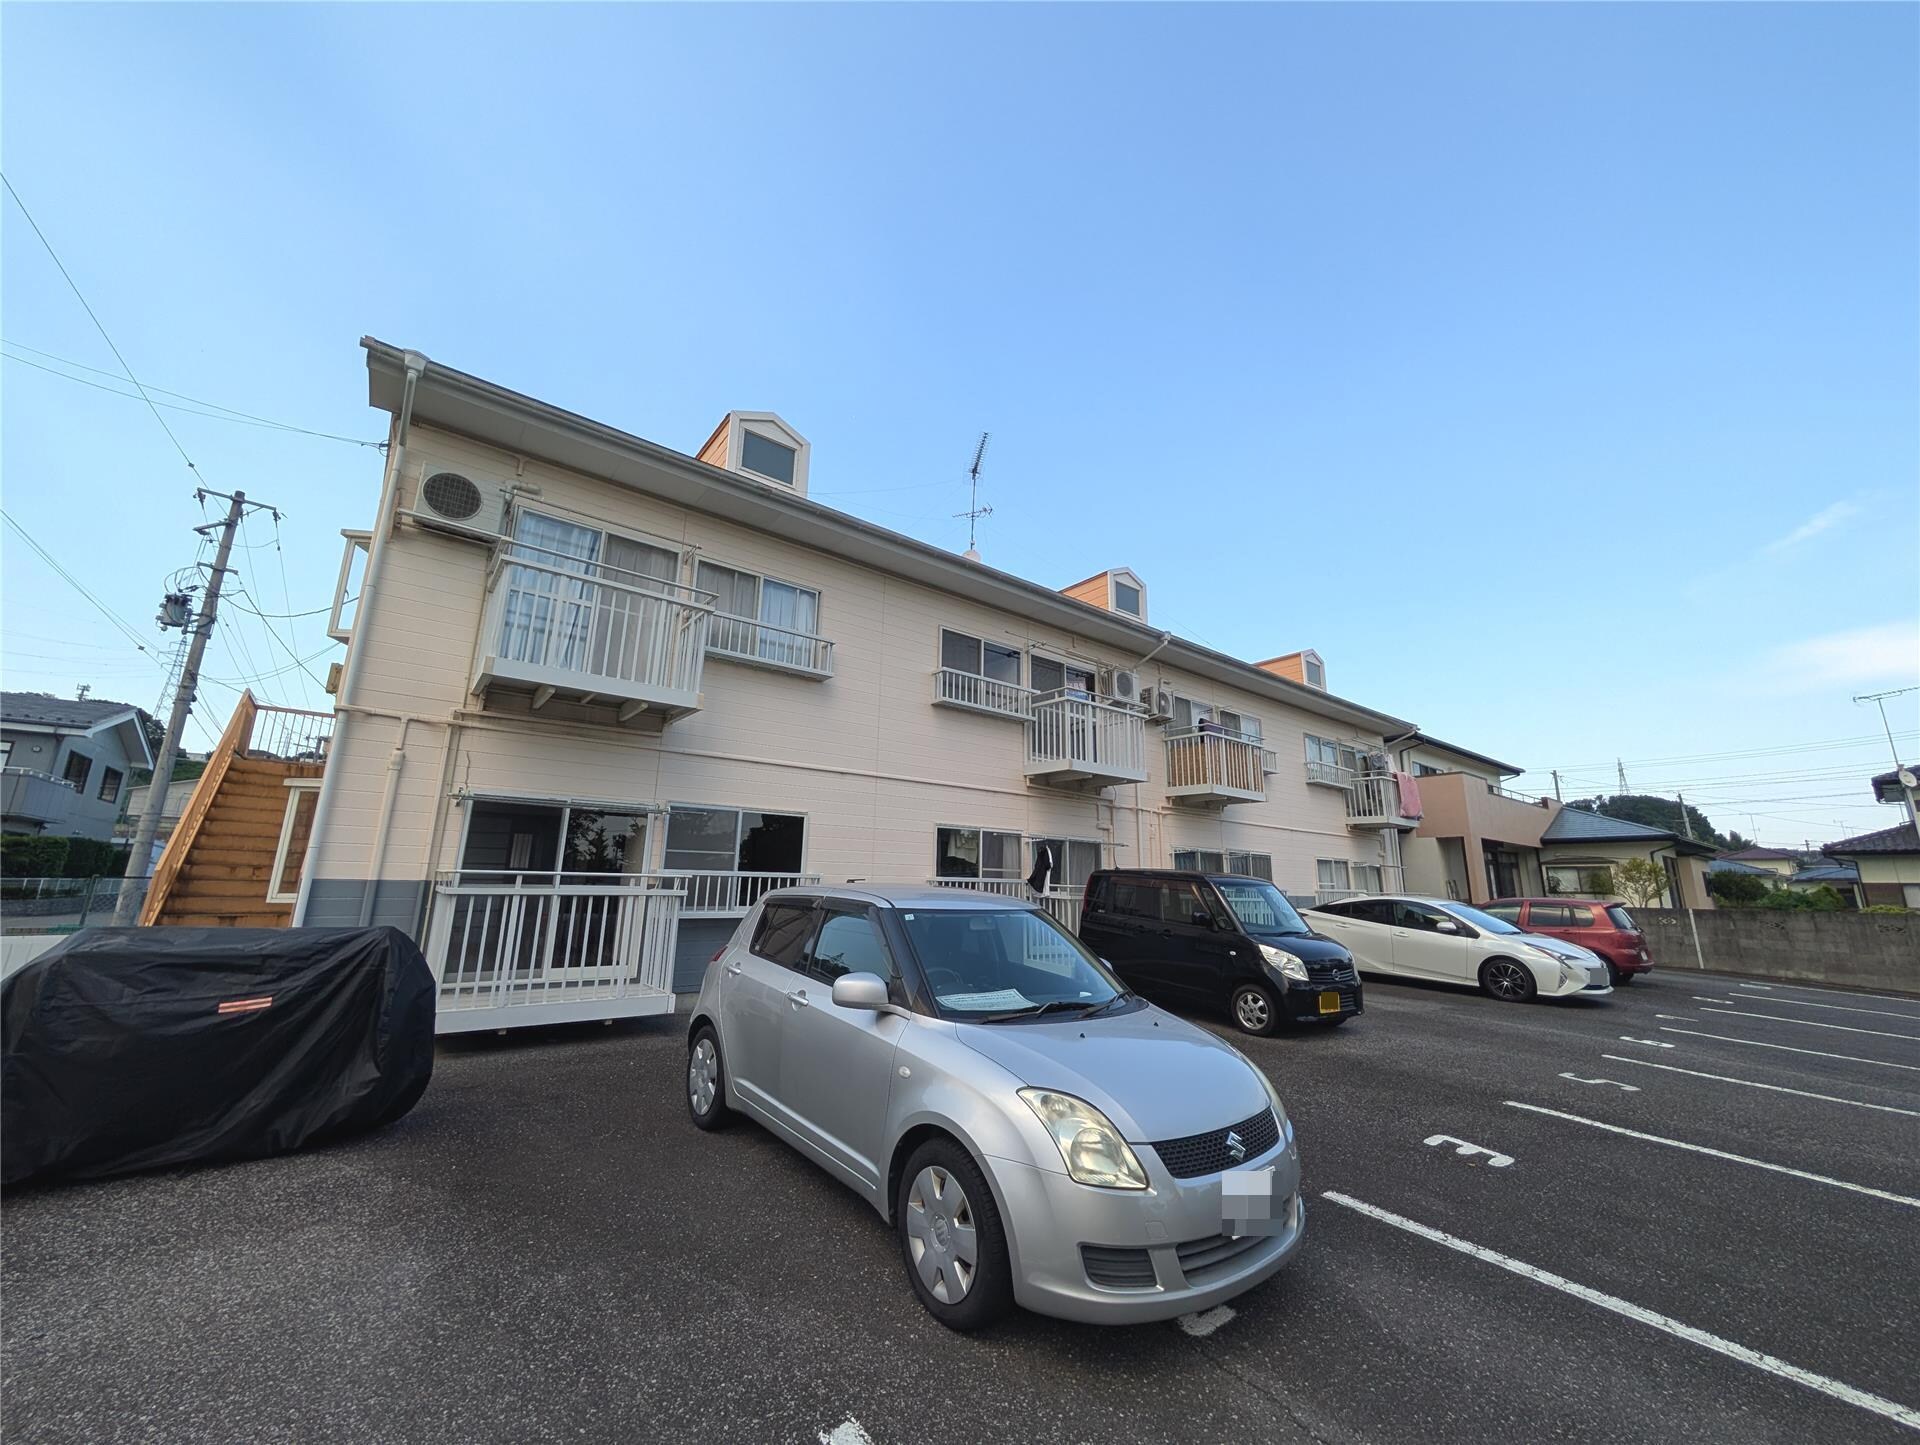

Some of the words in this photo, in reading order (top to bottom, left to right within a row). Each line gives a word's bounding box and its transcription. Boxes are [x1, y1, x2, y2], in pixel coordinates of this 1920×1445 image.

[1619, 1036, 1676, 1048] 6
[1558, 1072, 1641, 1091] 5
[1423, 1134, 1515, 1168] 3
